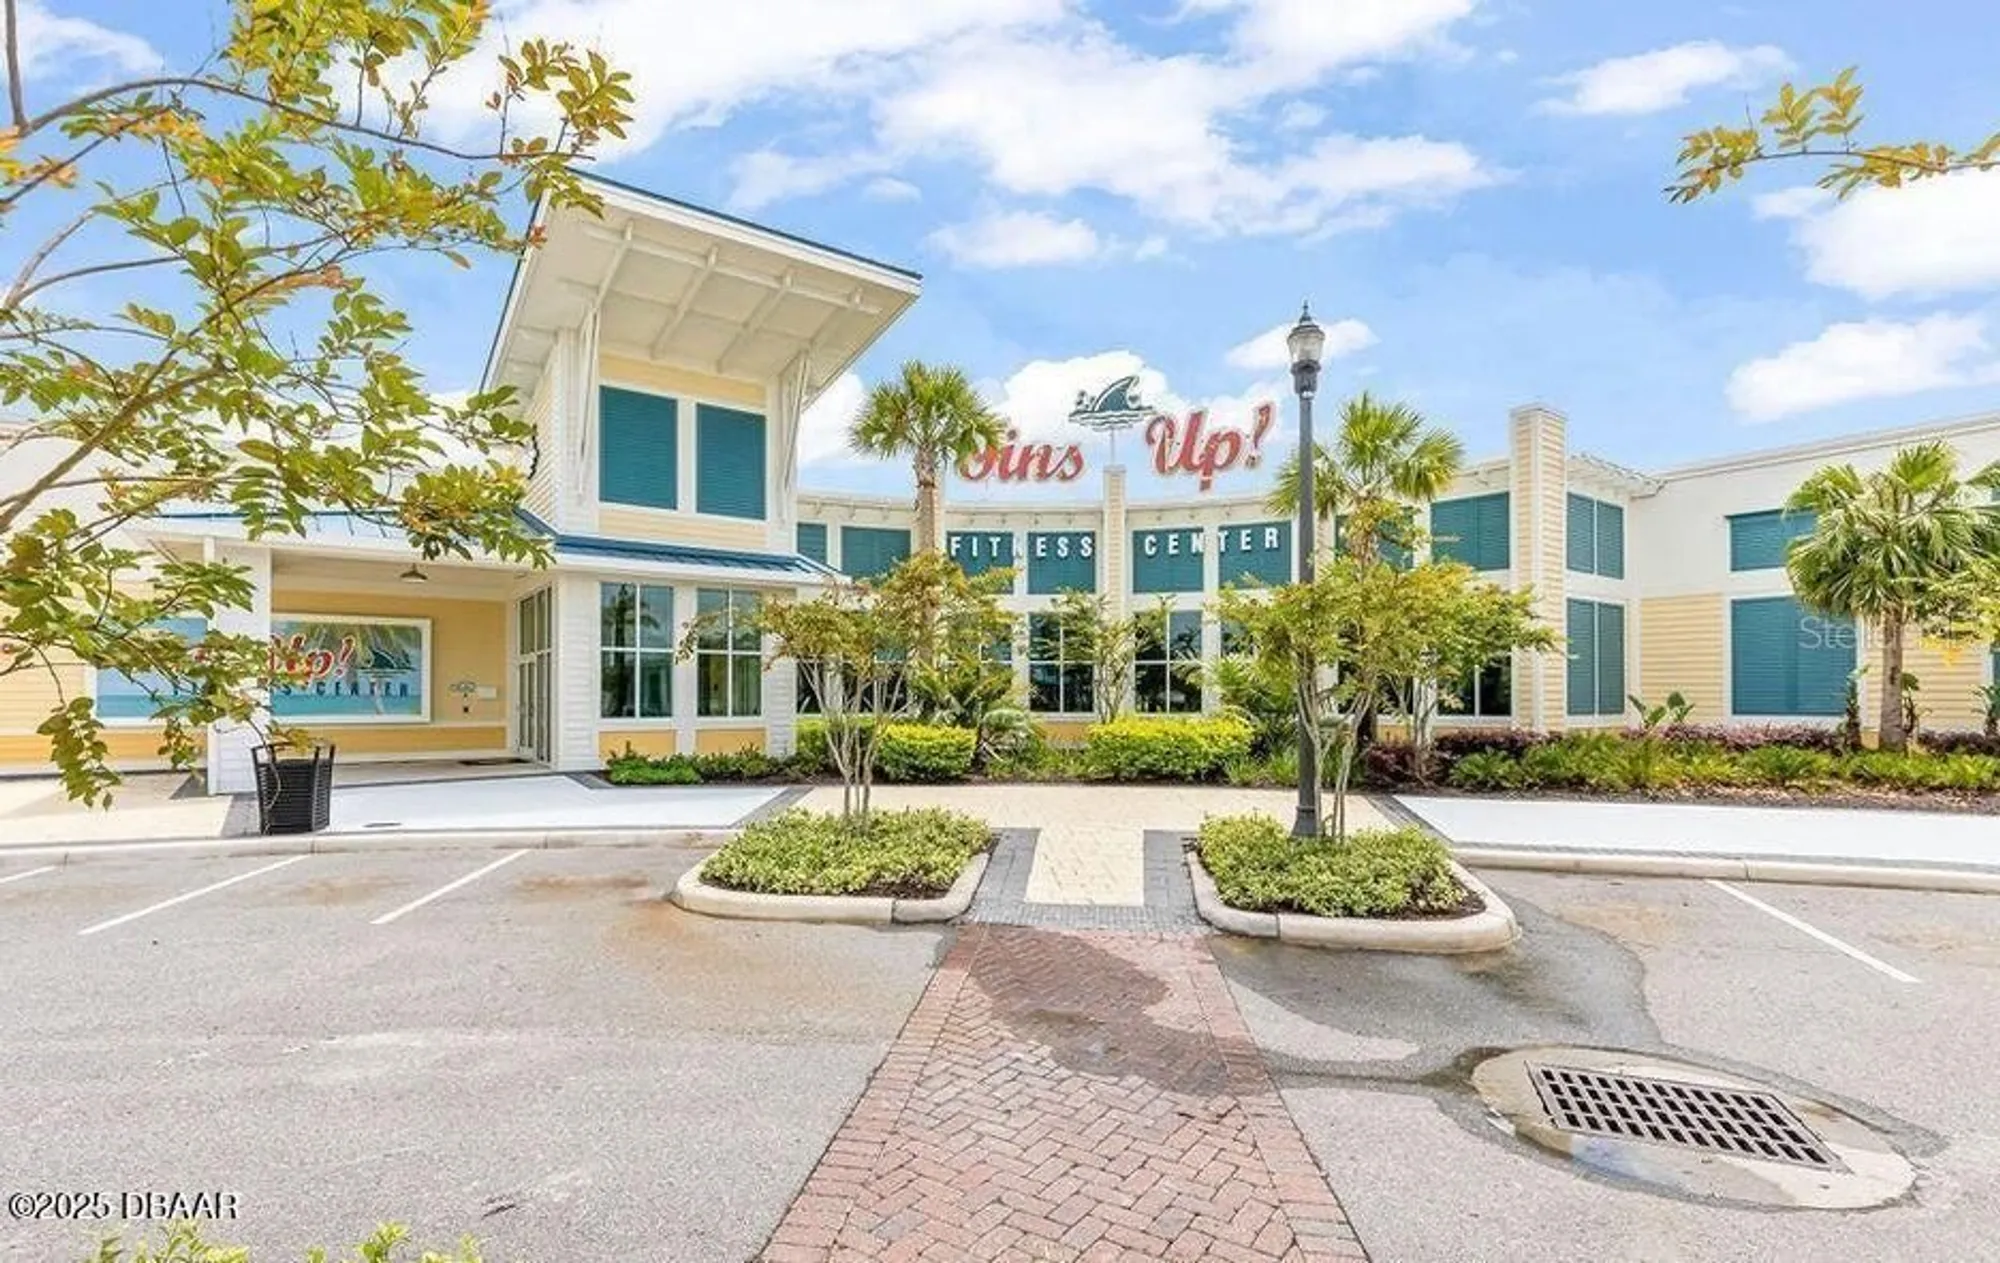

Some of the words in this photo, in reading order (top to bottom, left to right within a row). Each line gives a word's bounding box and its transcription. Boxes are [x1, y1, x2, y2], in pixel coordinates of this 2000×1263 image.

[1145, 403, 1272, 492] Up!
[951, 536, 1093, 558] FITNESS
[1144, 527, 1279, 556] CENTER
[316, 681, 409, 696] CENTER
